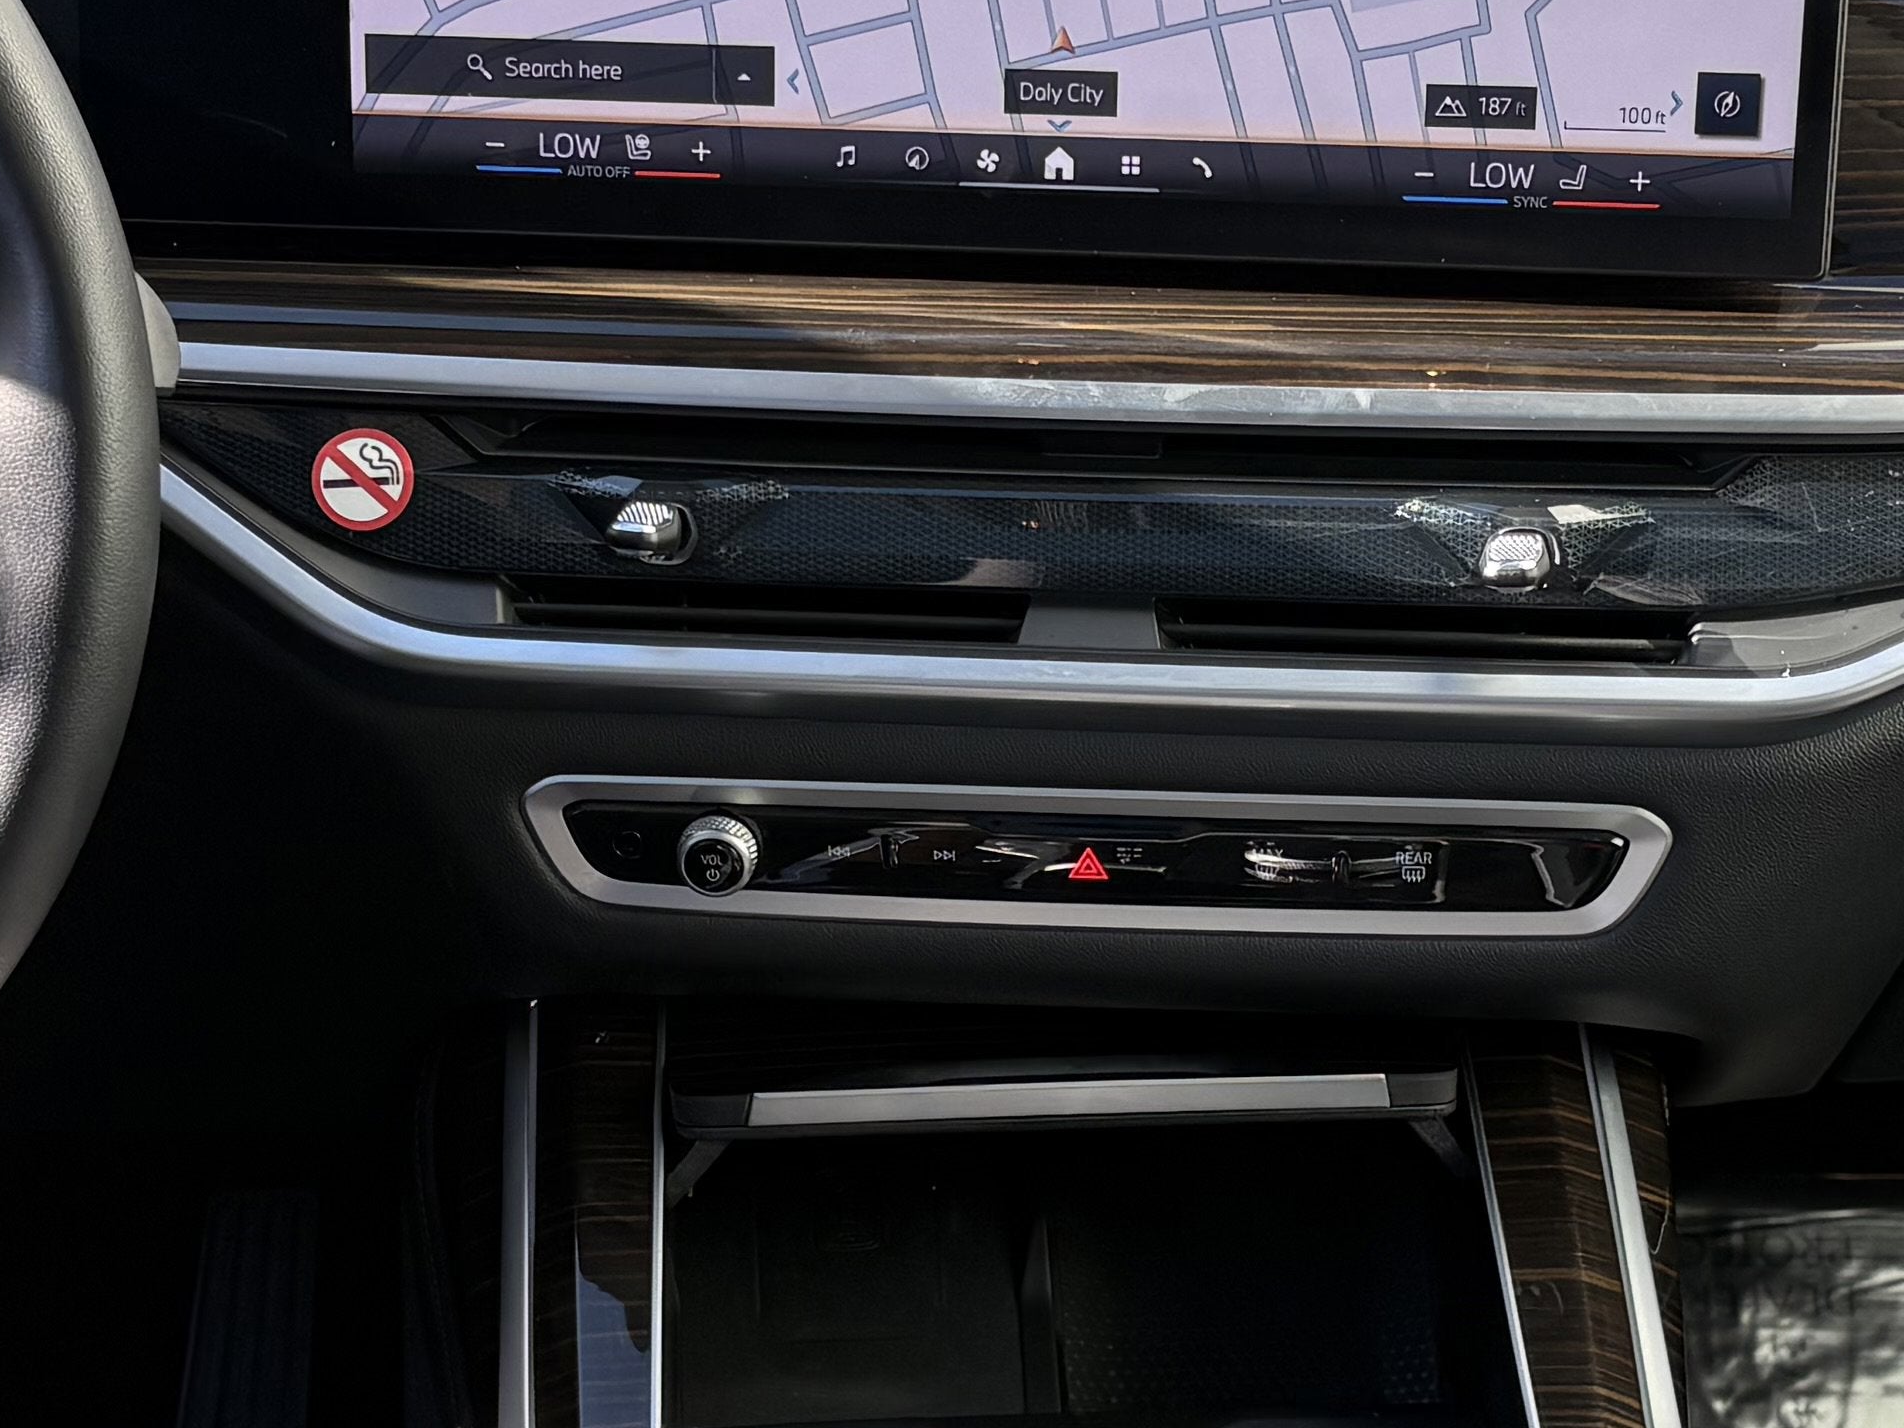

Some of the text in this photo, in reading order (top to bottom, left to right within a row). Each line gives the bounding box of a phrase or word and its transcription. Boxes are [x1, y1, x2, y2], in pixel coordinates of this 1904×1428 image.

[504, 57, 622, 81] Search here
[1019, 82, 1104, 106] Daly City
[1478, 97, 1526, 116] 187 ft
[1619, 107, 1666, 125] 100 ft
[539, 132, 600, 159] LOW
[567, 166, 631, 180] AUTO OFF
[1469, 162, 1535, 189] LOW
[1513, 195, 1548, 209] SYNC
[700, 853, 723, 867] VOL
[1396, 850, 1433, 865] REAR
